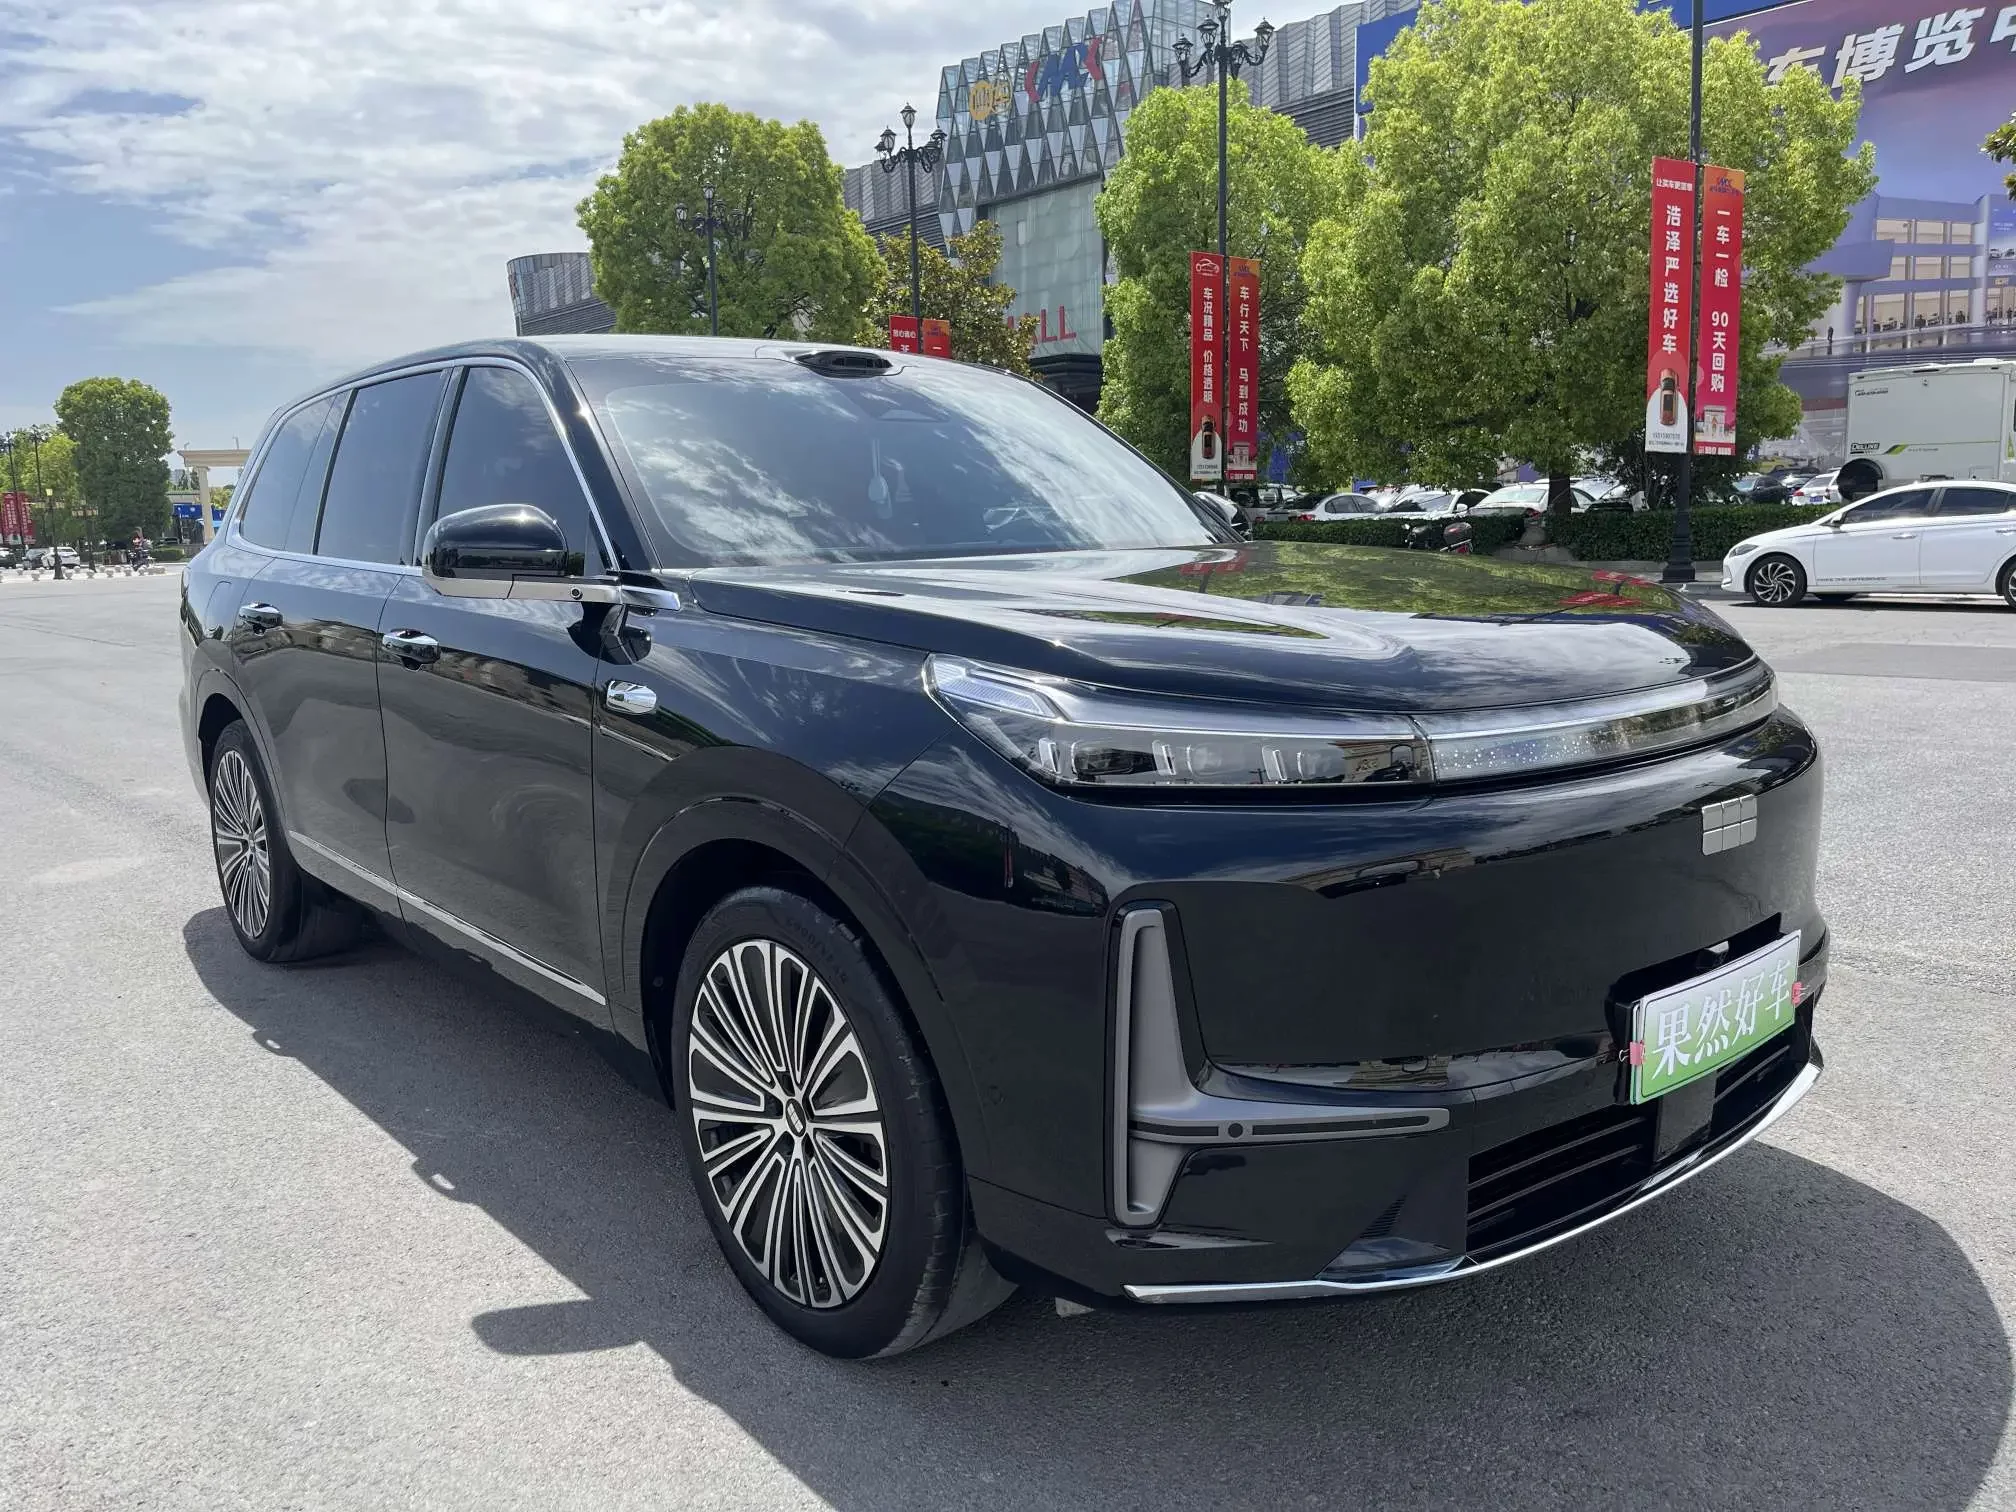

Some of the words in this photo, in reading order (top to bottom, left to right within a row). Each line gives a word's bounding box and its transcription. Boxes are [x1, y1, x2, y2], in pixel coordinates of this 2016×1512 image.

[1662, 204, 1681, 355] 浩泽严选好车
[1714, 210, 1731, 288] 一车一检
[1239, 286, 1250, 352] 车行天下
[1711, 311, 1729, 393] 90天回购
[1238, 367, 1249, 433] 马到成功
[1652, 959, 1793, 1080] 果然好车
